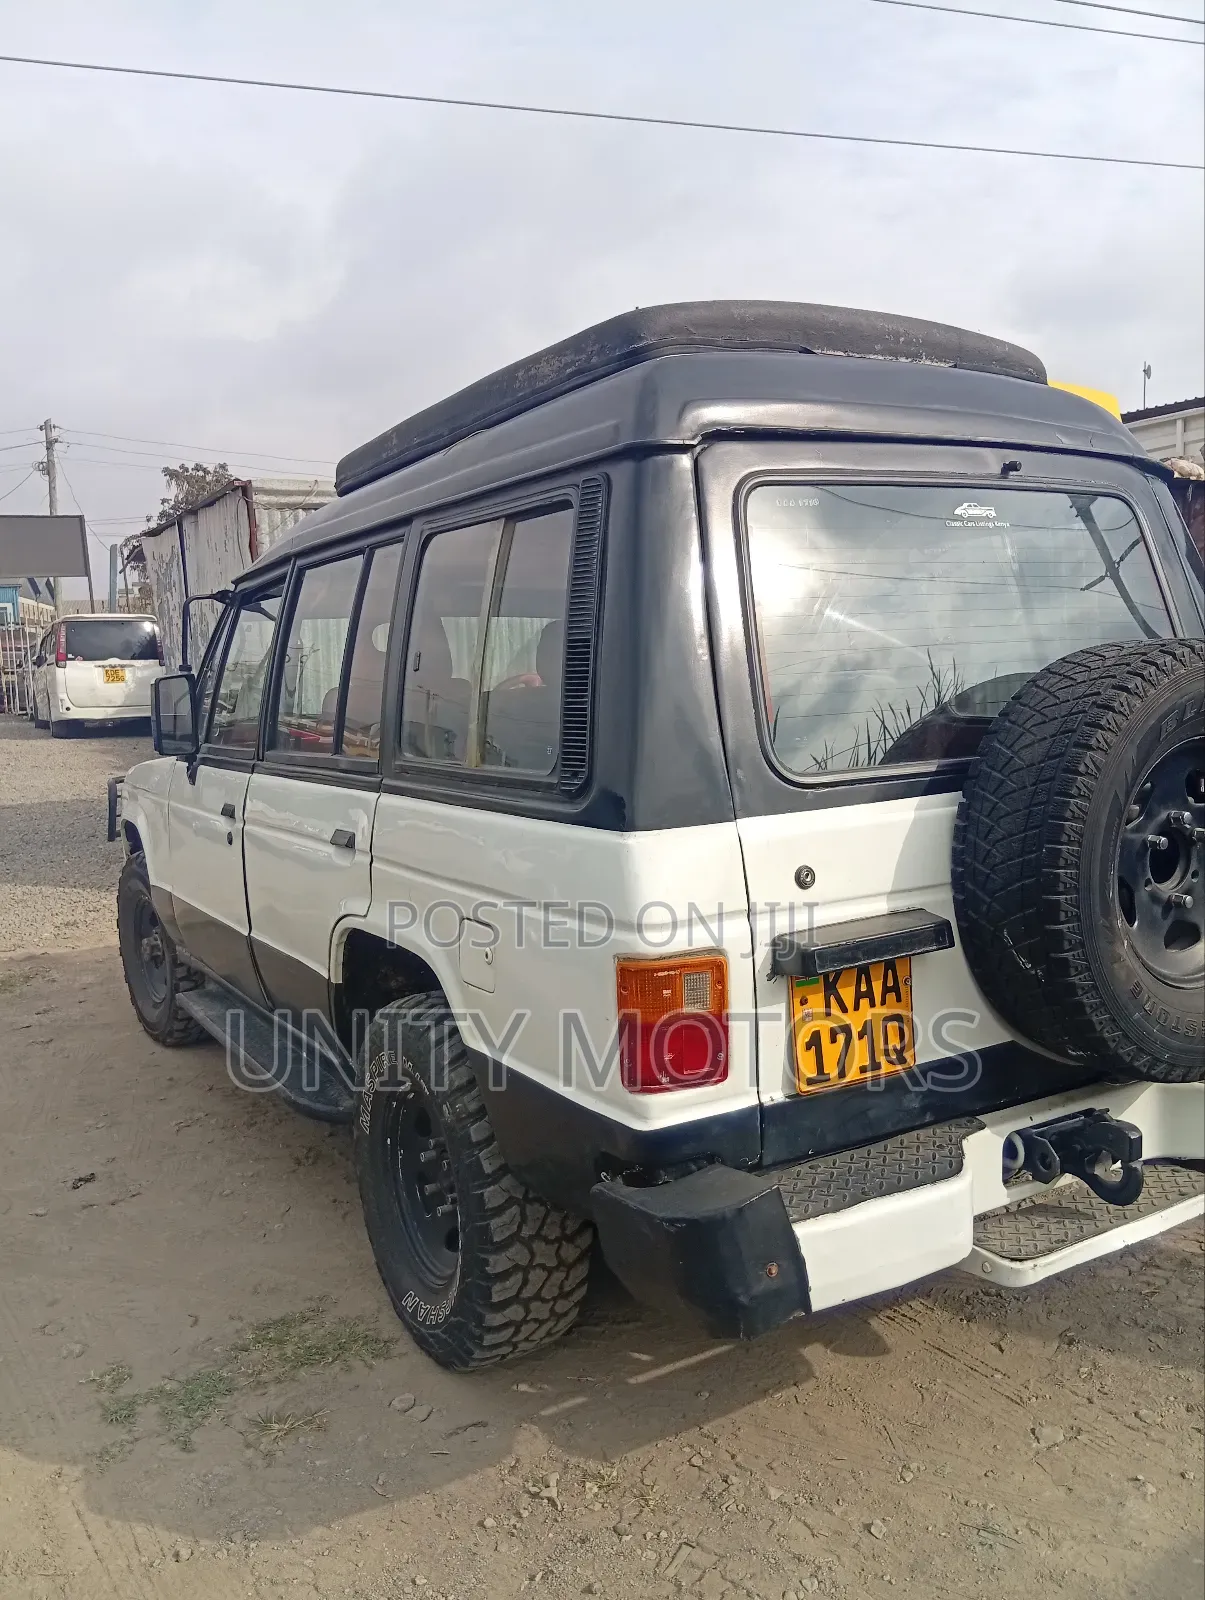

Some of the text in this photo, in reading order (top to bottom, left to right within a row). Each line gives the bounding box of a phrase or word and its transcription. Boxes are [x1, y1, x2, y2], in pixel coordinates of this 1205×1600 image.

[976, 520, 994, 529] Listings
[995, 520, 1010, 529] Kenya
[822, 959, 902, 1017] KAA
[805, 1014, 908, 1085] 171Q
[360, 1050, 398, 1135] MASPIRE
